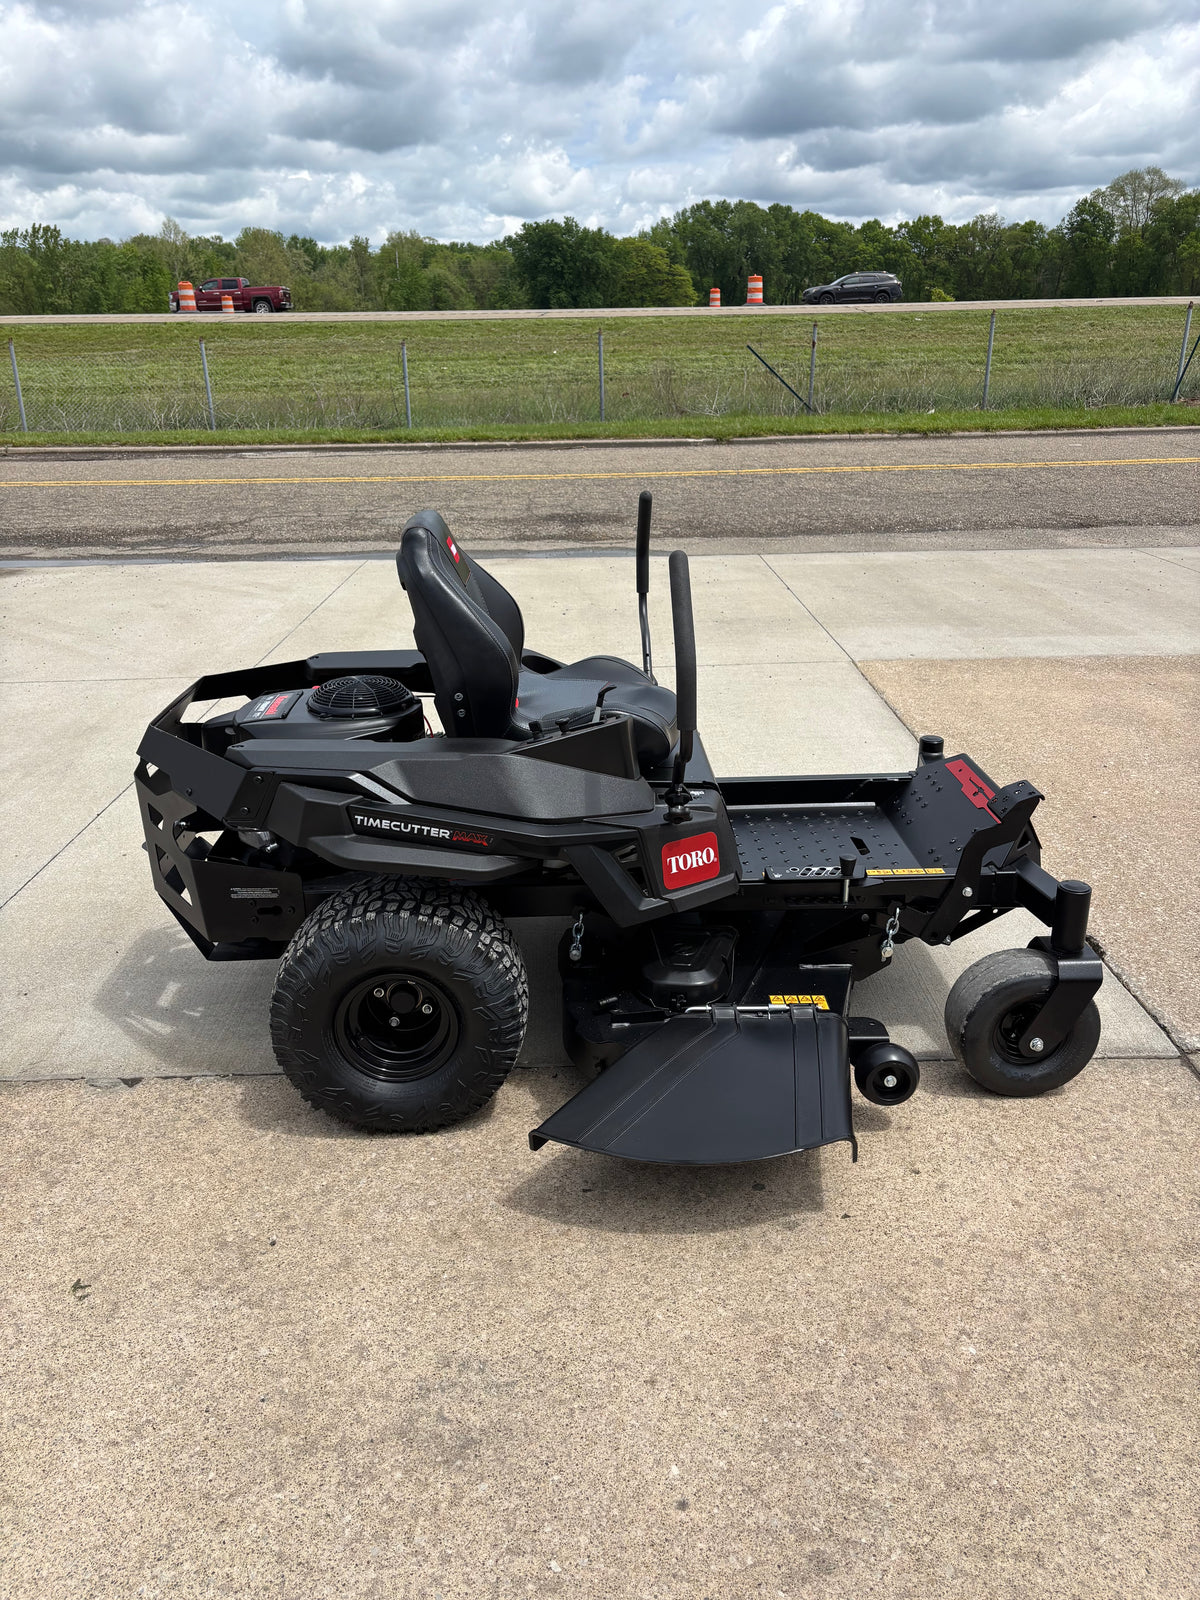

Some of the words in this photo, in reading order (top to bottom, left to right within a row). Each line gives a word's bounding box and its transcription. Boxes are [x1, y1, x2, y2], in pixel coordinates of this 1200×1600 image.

[354, 815, 450, 839] TIMECUTTER
[452, 831, 488, 846] MAX
[666, 847, 715, 874] TORO
